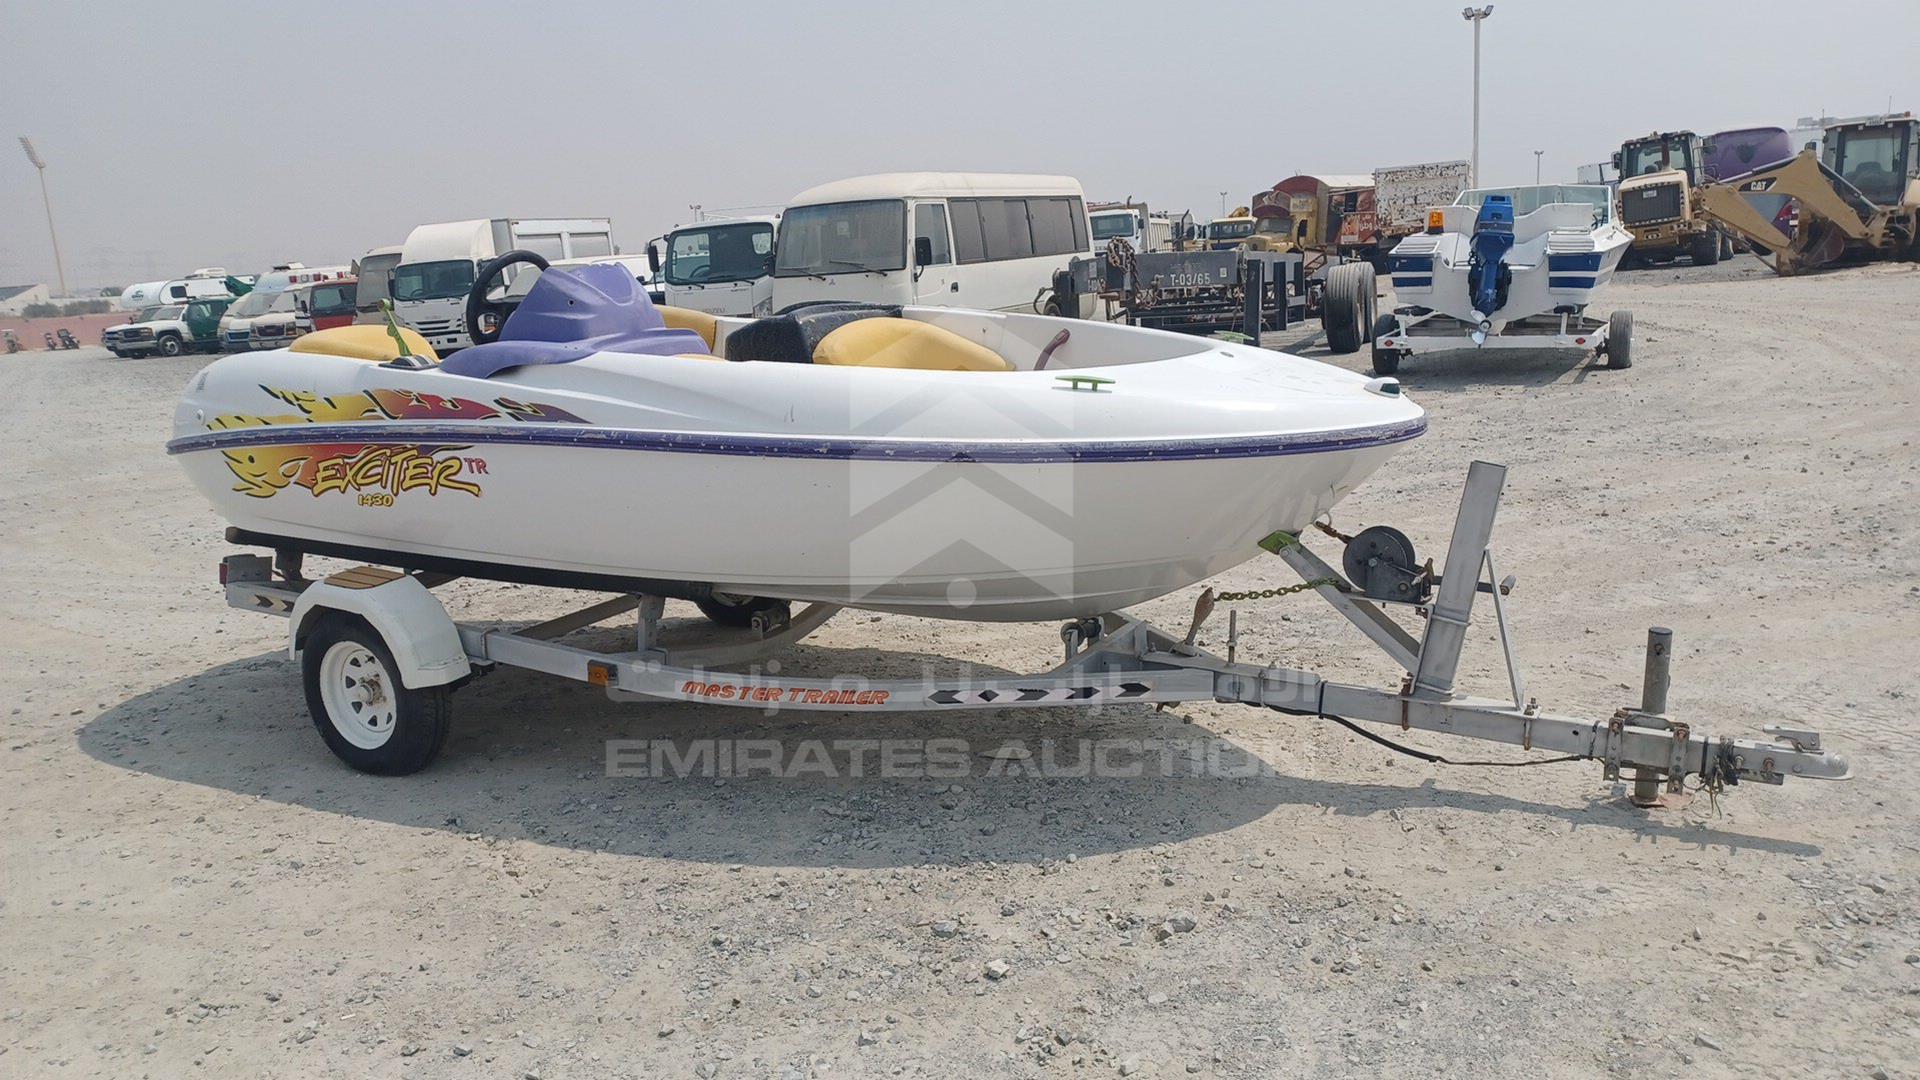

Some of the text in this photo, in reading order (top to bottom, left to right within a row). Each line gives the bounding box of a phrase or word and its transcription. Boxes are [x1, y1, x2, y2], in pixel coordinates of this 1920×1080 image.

[1750, 181, 1767, 191] CAT
[1170, 272, 1211, 287] T-03/65
[311, 447, 489, 498] EXCITER TR
[357, 493, 394, 507] 1430
[681, 680, 891, 706] MASTER TRAILER
